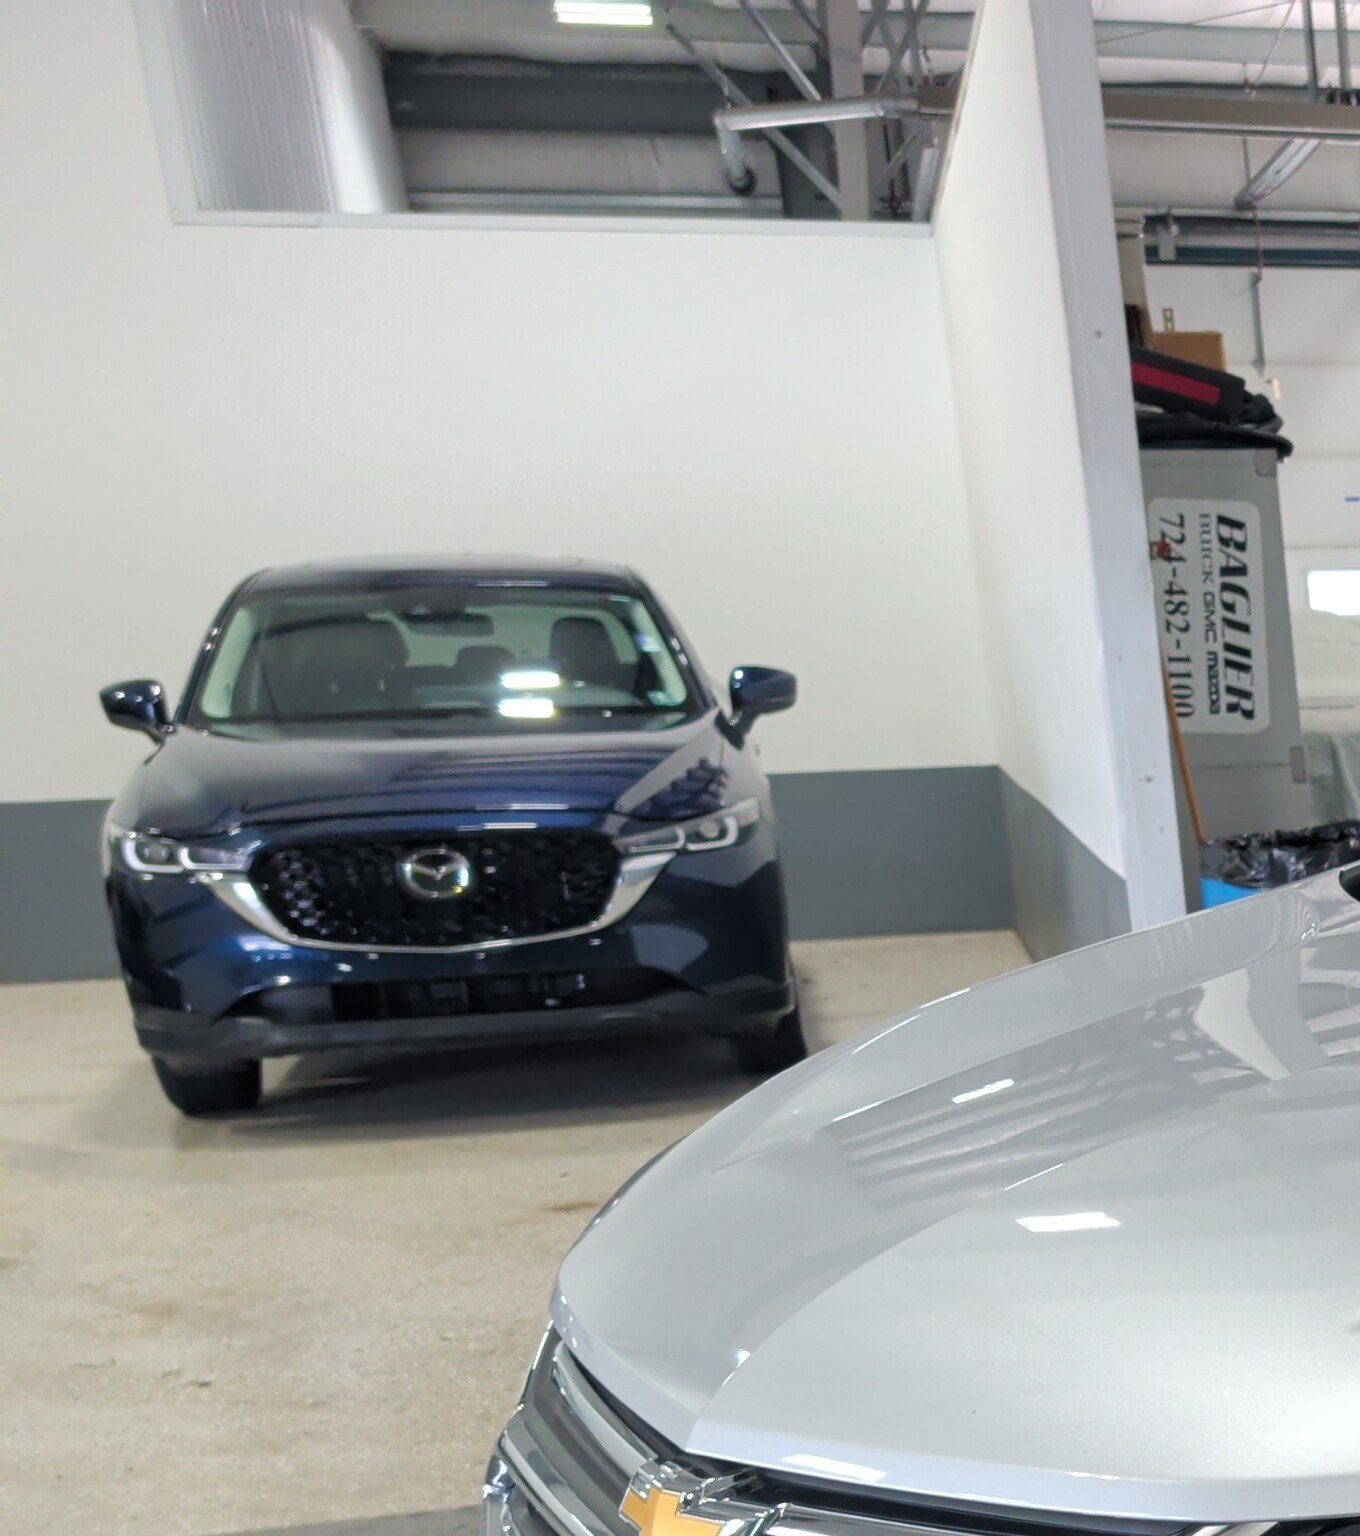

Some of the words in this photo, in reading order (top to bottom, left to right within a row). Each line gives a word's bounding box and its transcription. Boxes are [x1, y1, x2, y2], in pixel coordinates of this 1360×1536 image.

[1159, 513, 1196, 718] 724-482-1100
[1199, 513, 1214, 585] BUICK
[1202, 592, 1218, 644] GMC
[1215, 513, 1256, 721] BAGLIER
